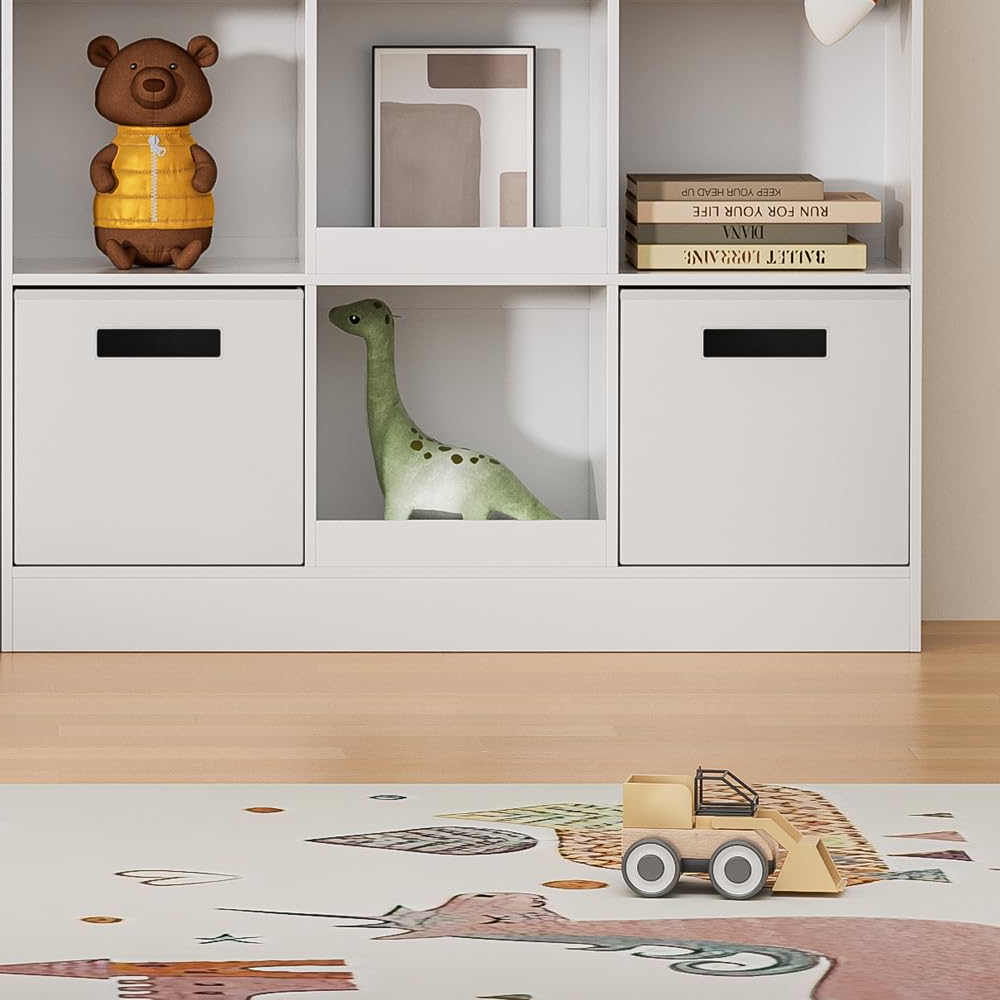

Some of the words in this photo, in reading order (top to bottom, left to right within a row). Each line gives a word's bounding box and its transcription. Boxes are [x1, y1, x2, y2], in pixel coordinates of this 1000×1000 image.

[682, 187, 694, 197] UP
[697, 187, 724, 197] HEAD
[726, 187, 754, 197] YOUR
[756, 187, 781, 197] KEEP
[693, 206, 719, 217] LIFE
[725, 206, 762, 217] YOUR
[768, 206, 794, 217] FOR
[800, 206, 828, 217] RUN
[723, 225, 764, 239] DIANA
[684, 250, 760, 264] LORRAINE
[766, 250, 825, 264] BALLET
